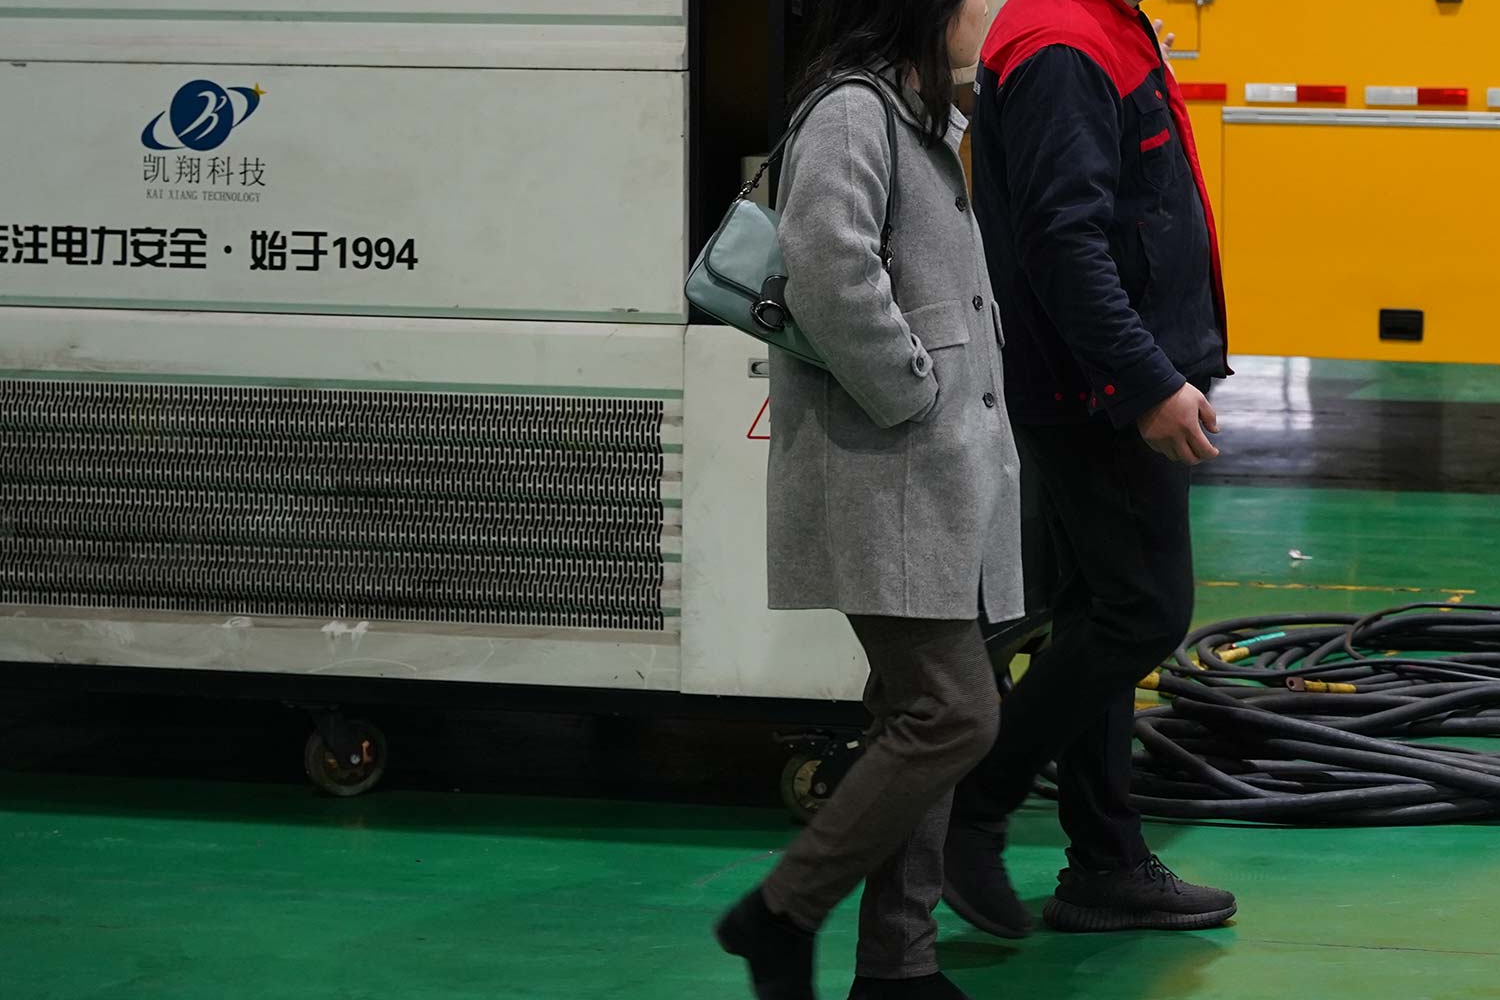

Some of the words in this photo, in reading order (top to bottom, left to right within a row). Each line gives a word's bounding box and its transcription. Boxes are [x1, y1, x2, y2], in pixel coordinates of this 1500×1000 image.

[143, 153, 266, 186] 凯翔科技
[146, 189, 164, 200] KAI
[168, 189, 198, 201] XIANG
[202, 191, 261, 202] TECHNOLOGY
[0, 224, 419, 272] 注电力安全·始于1994
